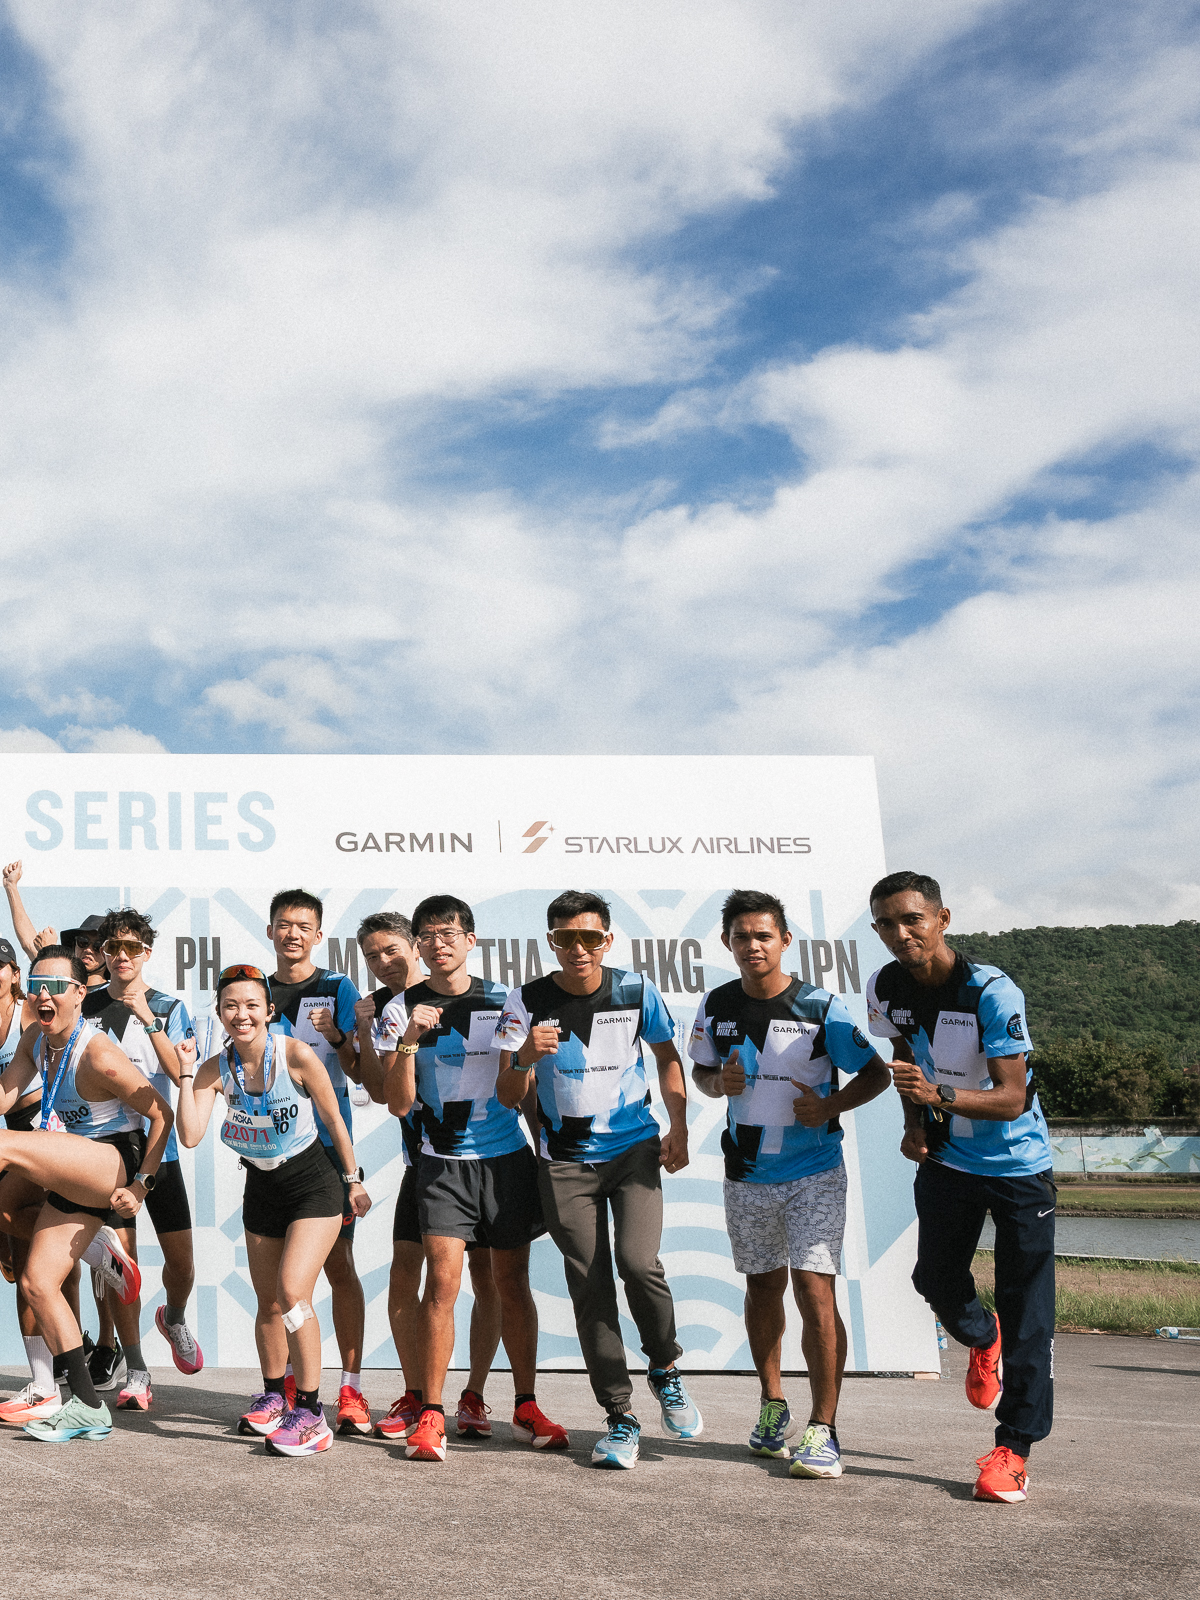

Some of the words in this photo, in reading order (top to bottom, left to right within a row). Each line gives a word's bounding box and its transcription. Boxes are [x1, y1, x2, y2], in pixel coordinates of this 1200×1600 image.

[25, 790, 278, 852] SERIES
[335, 831, 473, 853] GARMIN
[564, 836, 684, 854] STARLUX
[691, 836, 811, 854] AIRLINES
[476, 938, 543, 988] THA
[631, 938, 705, 993] HKG
[790, 940, 861, 993] JPN
[891, 1008, 912, 1017] amino
[597, 1017, 631, 1025] GARMIN
[717, 1020, 737, 1029] amino
[893, 1016, 908, 1025] VITAL
[941, 1018, 974, 1027] GARMIN
[716, 1028, 731, 1036] VITAL
[773, 1026, 810, 1035] GARMIN
[59, 1106, 89, 1123] ZERO
[233, 1113, 253, 1125] HOKA
[224, 1122, 270, 1143] 22071
